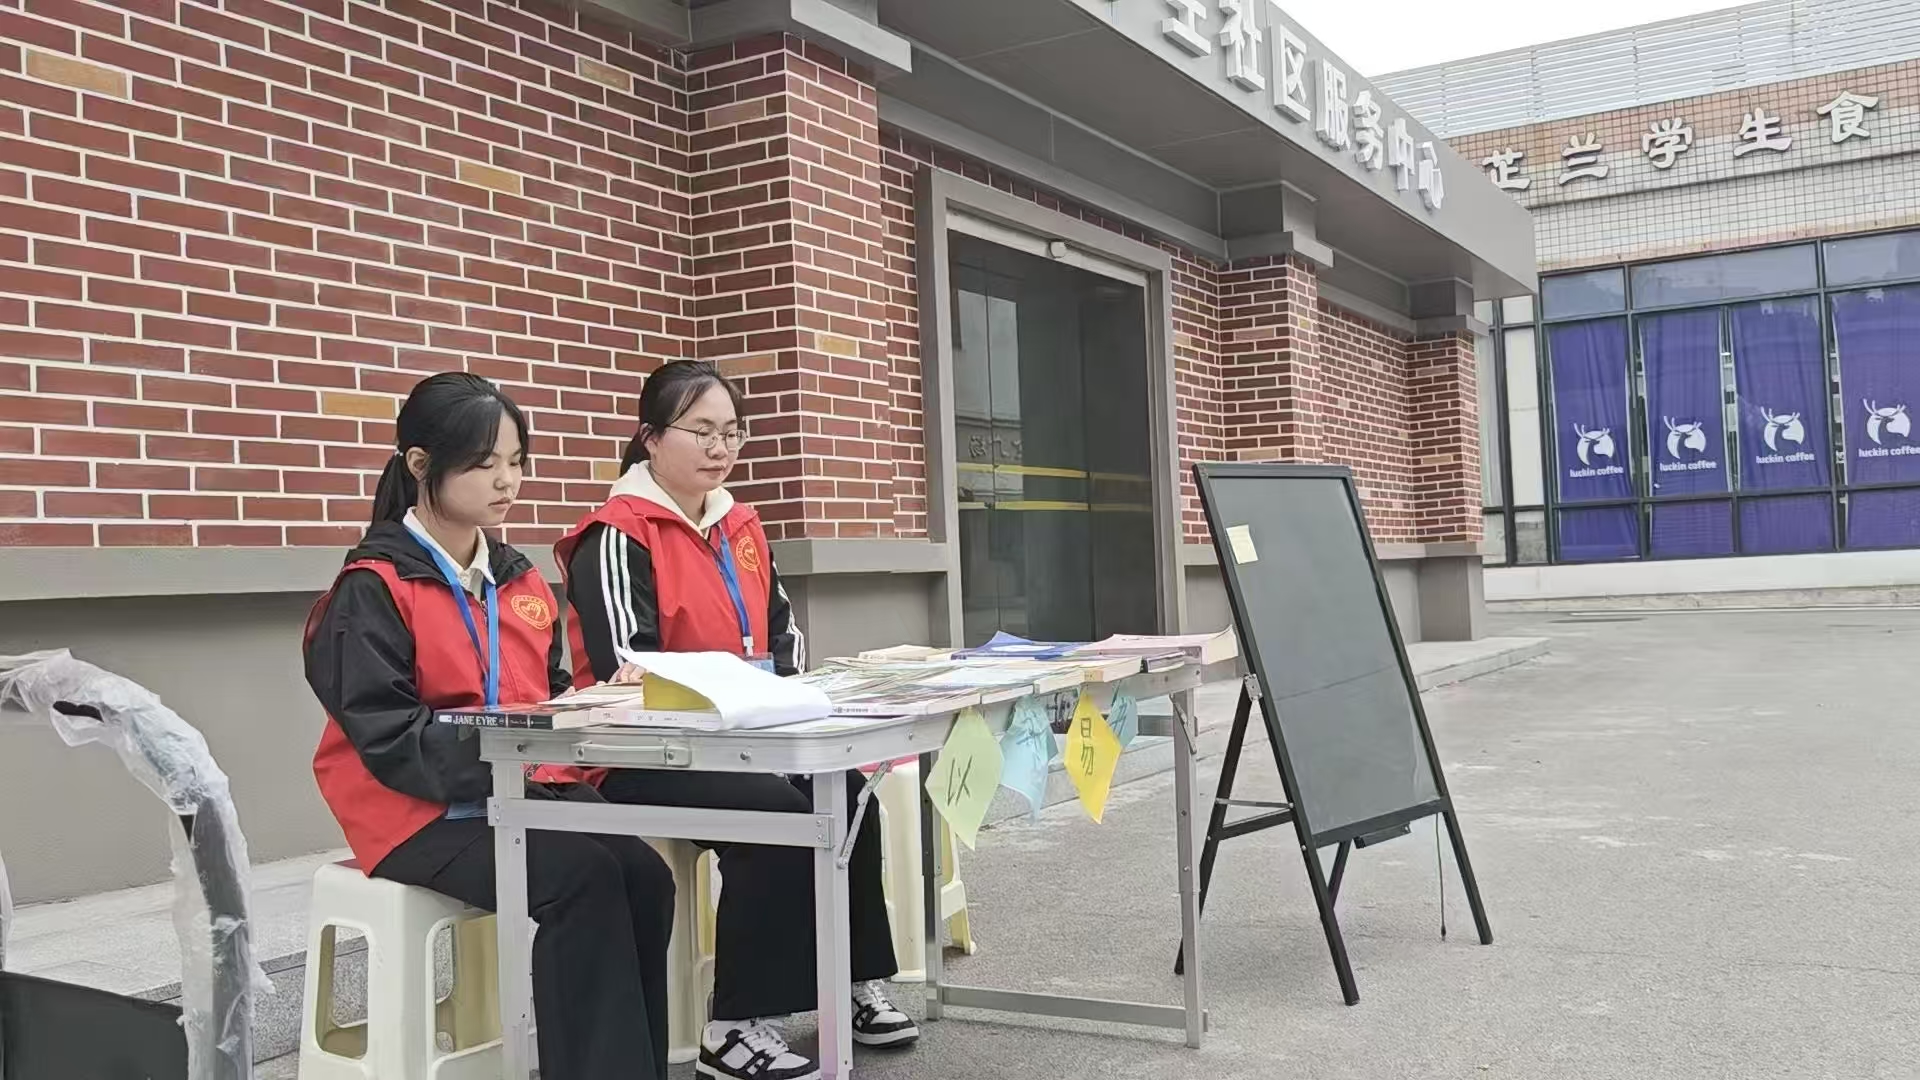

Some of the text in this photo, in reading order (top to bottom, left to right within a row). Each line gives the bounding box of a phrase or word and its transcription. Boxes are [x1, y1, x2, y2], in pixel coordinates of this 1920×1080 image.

[1482, 90, 1879, 190] 芷兰学生食
[1756, 452, 1815, 464] luckin coffee
[1859, 447, 1888, 458] luckin
[1660, 460, 1717, 471] luckin coffee
[1570, 466, 1624, 477] luckin coffee
[453, 715, 475, 725] JANE
[475, 715, 498, 726] EYRE
